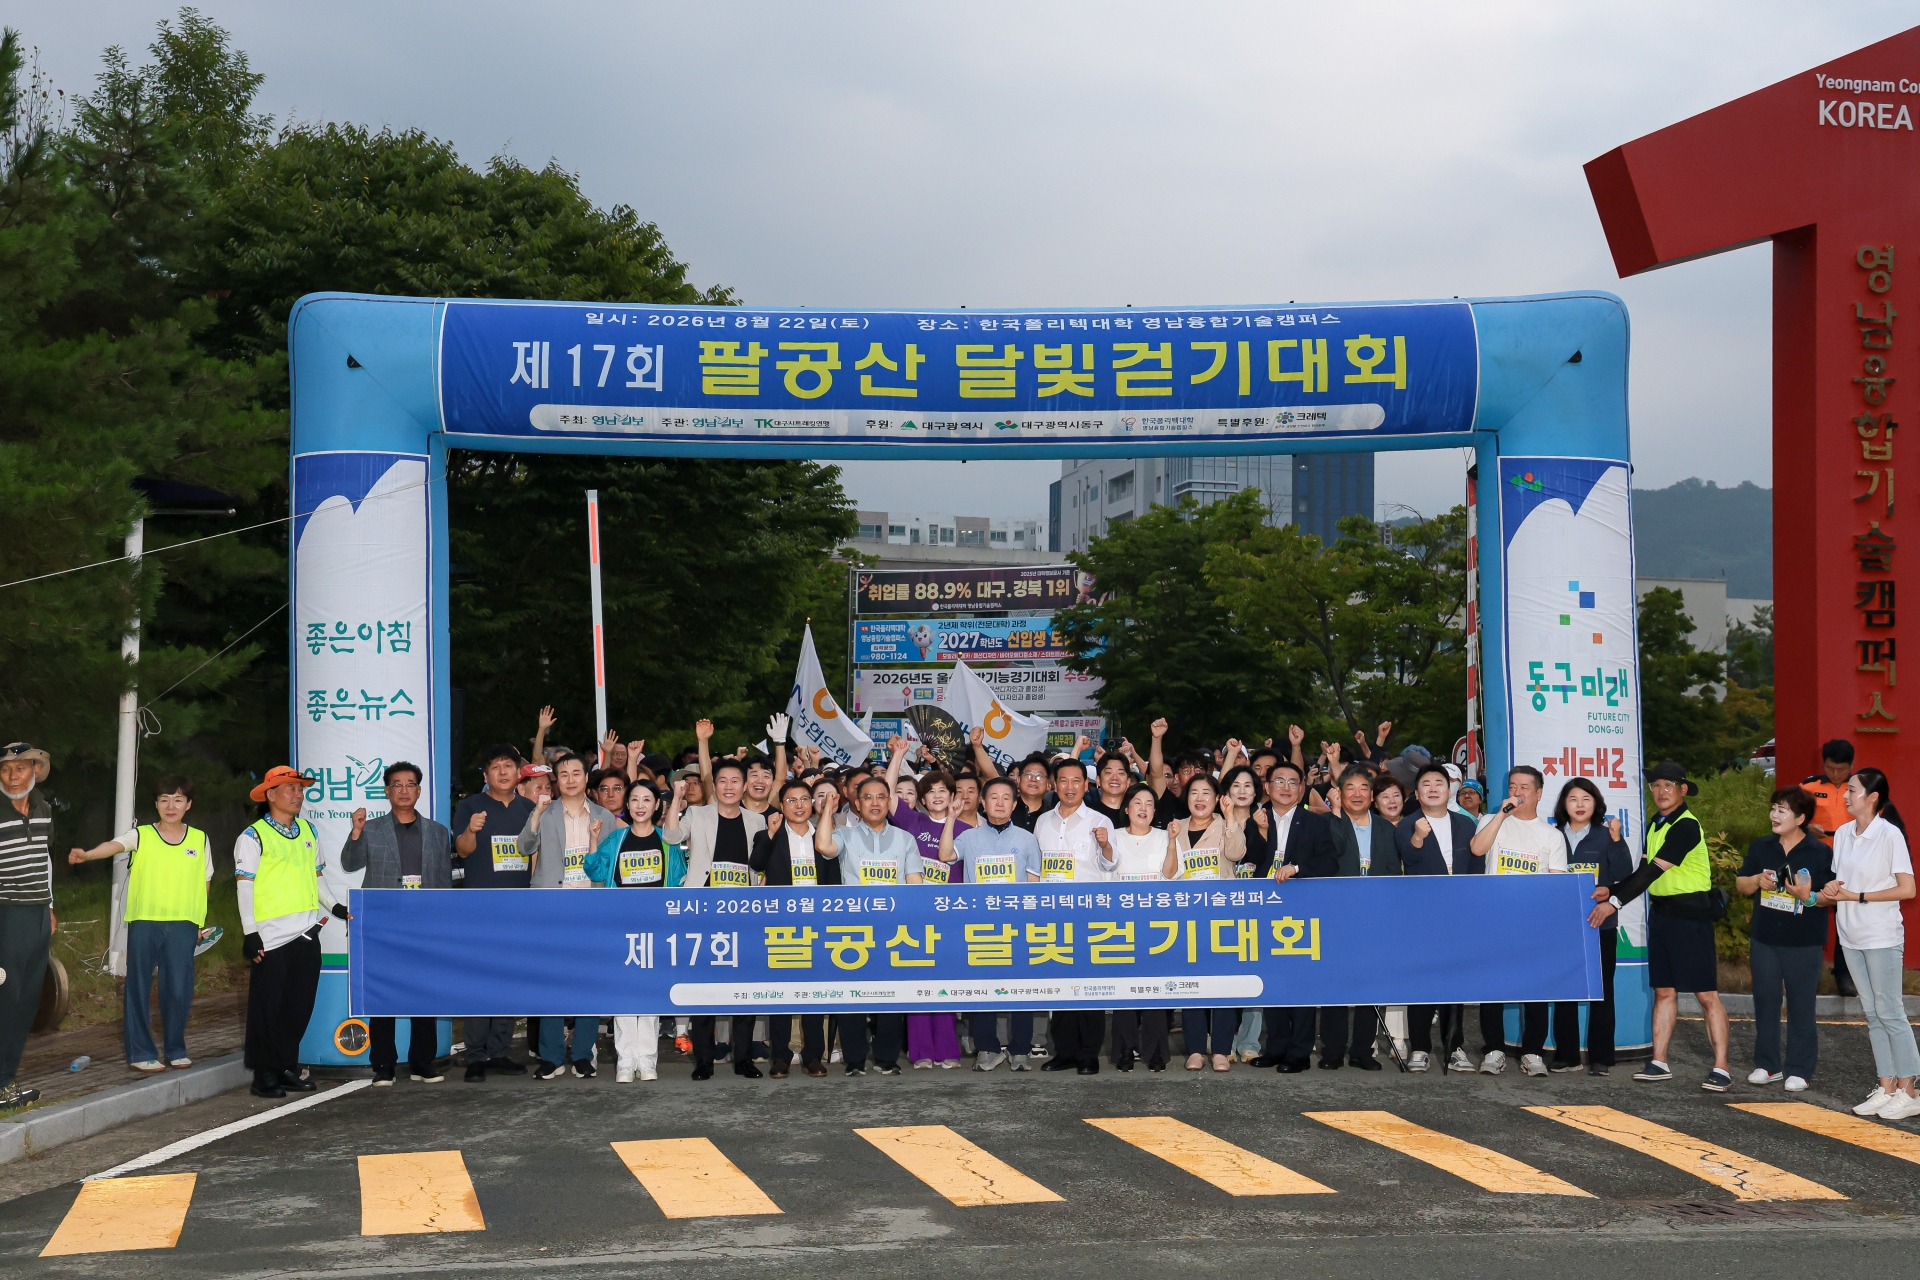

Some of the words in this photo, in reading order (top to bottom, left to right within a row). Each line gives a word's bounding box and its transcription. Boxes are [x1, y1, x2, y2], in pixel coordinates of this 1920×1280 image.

[1816, 74, 1895, 94] Yeongnam
[1819, 100, 1913, 131] KOREA
[585, 312, 637, 326] 일시:
[648, 314, 726, 328] 2026년
[735, 316, 770, 329] 8월
[779, 317, 870, 330] 22일(토)
[918, 318, 969, 331] 장소:
[979, 316, 1134, 332] 한국폴리텍대학
[1142, 313, 1341, 330] 영남융합기술캠퍼스
[510, 341, 664, 392] 제17회
[699, 340, 925, 399] 팔공산
[955, 333, 1407, 398] 달빛걷기대회
[560, 415, 587, 424] 주최:
[662, 418, 688, 427] 주관:
[866, 420, 893, 429] 후원:
[922, 421, 983, 430] 대구광역시
[1022, 420, 1103, 429] 대구광역시동구
[1218, 417, 1269, 428] 특별후원:
[1853, 244, 1899, 734] 영남융합기술캠퍼스
[868, 584, 910, 601] 취업률
[915, 582, 972, 600] 88.9%
[1046, 579, 1070, 597] 1위
[938, 621, 958, 630] 2년제
[1012, 619, 1027, 628] 과정
[306, 620, 411, 655] 좋은아침
[1007, 630, 1046, 648] 신입생
[873, 673, 933, 684] 2026년도
[307, 688, 415, 722] 좋은뉴스
[1588, 712, 1616, 722] FUTURE
[1618, 713, 1630, 723] CITY
[1588, 725, 1624, 735] DONG-GU
[1054, 734, 1074, 746] 실무과정
[1543, 747, 1627, 788] 제대로
[308, 809, 324, 819] The
[495, 844, 516, 855] 100
[623, 856, 660, 868] 10019
[1043, 859, 1073, 871] 10026
[1184, 856, 1218, 870] 10003
[1501, 856, 1536, 873] 10006
[714, 870, 747, 883] 10023
[863, 868, 897, 879] 10002
[978, 864, 1012, 876] 10001
[665, 899, 708, 914] 일시:
[716, 899, 779, 914] 2026년
[786, 898, 817, 913] 8월
[821, 897, 896, 913] 22일(토)
[934, 896, 976, 911] 장소:
[984, 894, 1111, 910] 한국폴리텍대학
[1119, 890, 1283, 909] 영남융합기술캠퍼스
[624, 931, 739, 969] 제17회
[764, 925, 941, 971] 팔공산
[963, 916, 1322, 966] 달빛걷기대회
[916, 989, 933, 997] 후원:
[951, 989, 988, 997] 대구광역시
[1011, 987, 1061, 995] 대구광역시동구
[1130, 986, 1161, 994] 특별후원:
